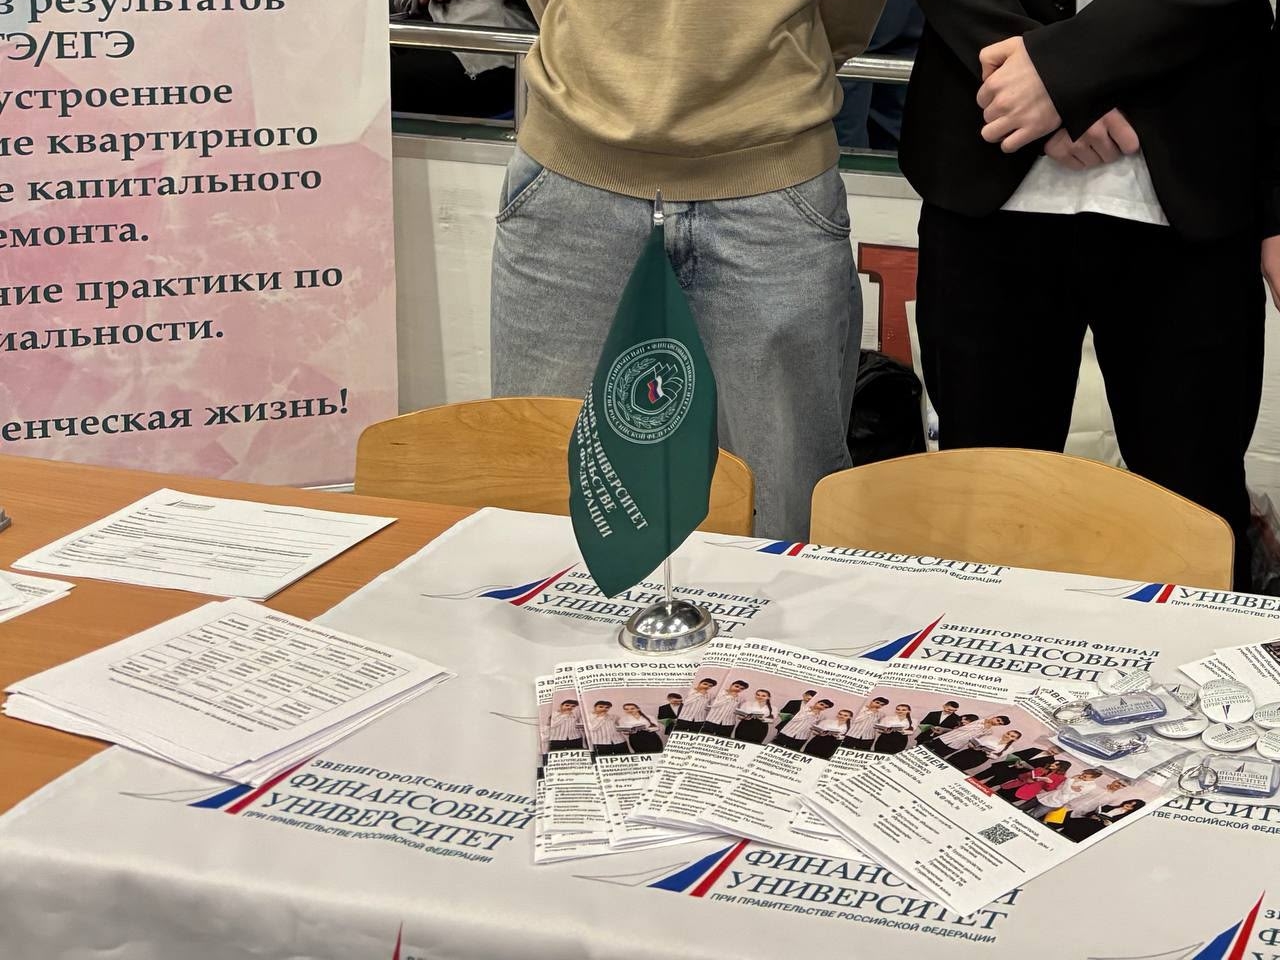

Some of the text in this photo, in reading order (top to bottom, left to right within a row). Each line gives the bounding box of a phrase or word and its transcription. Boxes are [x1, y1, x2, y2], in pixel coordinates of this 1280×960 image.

[0, 30, 135, 67] Э/ЕГЭ
[47, 125, 318, 158] квартирного
[27, 169, 322, 200] капитального
[76, 271, 282, 309] практики
[294, 266, 343, 292] по
[204, 387, 348, 427] жизнь!
[592, 429, 649, 531] УНИВЕРСИТЕТ
[801, 553, 1002, 584] ПРИ ПРАВИТЕЛЬСТВЕ РОССИЙСКОЙ ФЕДЕРАЦИИ
[523, 605, 616, 626] ПРИ ПРАВИТЕЛЬСТВЕ
[707, 589, 772, 607] ФИЛИАЛ
[1171, 599, 1191, 608] ПРИ
[1191, 602, 1266, 618] ПРАВИТЕЛЬСТВЕ
[931, 635, 1156, 672] ФИНАНСОВЫЙ
[939, 623, 1161, 658] ЗВЕНИГОРОДСКИЙ ФИЛИАЛ
[920, 647, 1104, 683] УНИВЕРСИТ
[600, 755, 652, 764] ПРИЕМ
[764, 745, 812, 764] ПРИЕМ
[289, 772, 539, 830] ФИНАНСОВЫЙ
[310, 759, 474, 796] ЗВЕНИГОРОДСКИЙ
[475, 787, 538, 808] ФИЛИА
[242, 810, 495, 864] ПРИ ПРАВИТЕЛЬСТВЕ РОССИЙСКОЙ ФЕДЕРАЦИИ
[262, 792, 516, 851] УНИВЕРСИТЕТ
[1173, 813, 1249, 831] РОССИЙСКОЙ
[710, 892, 997, 943] ПРИ ПРАВИТЕЛЬСТВЕ РОССИЙСКОЙ ФЕДЕРАЦИИ
